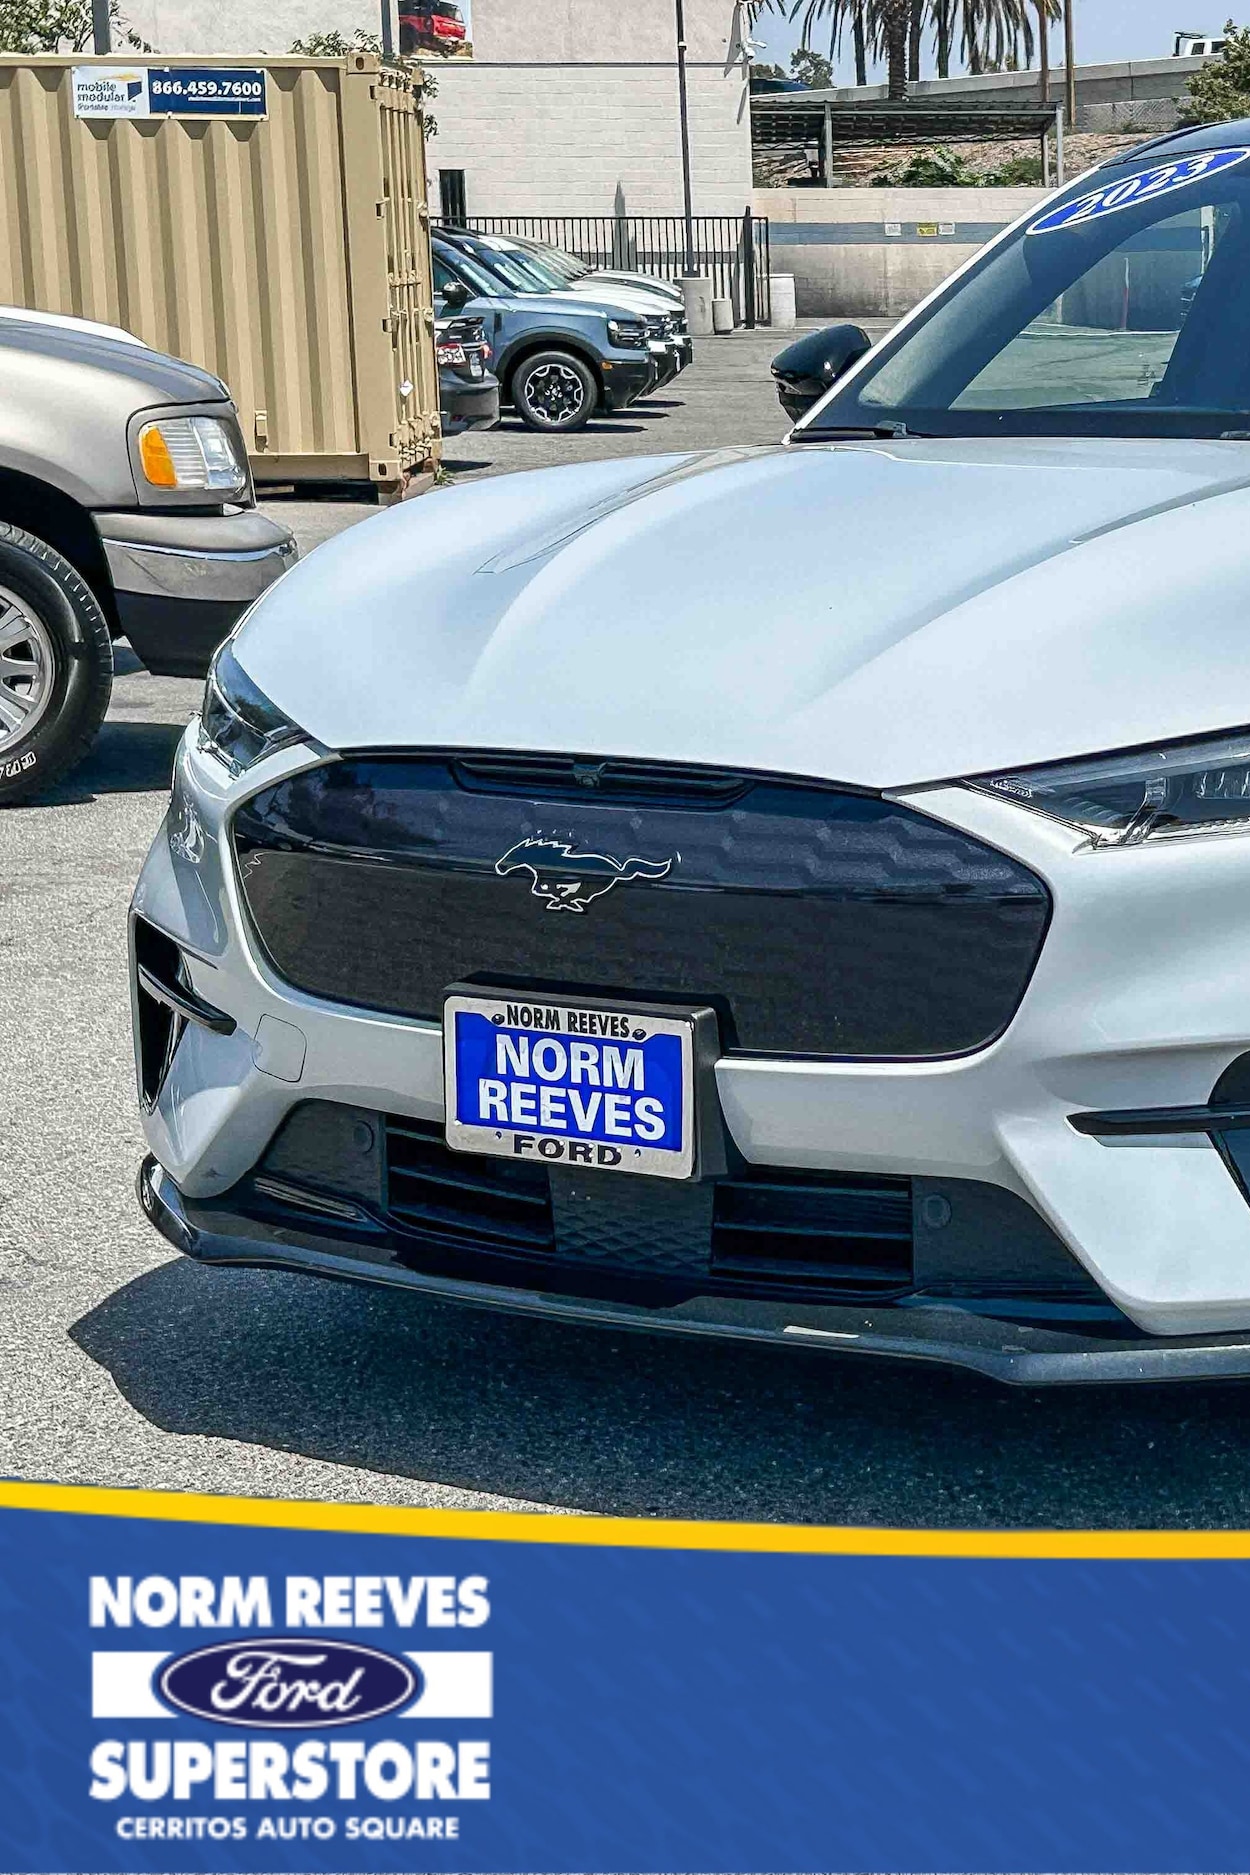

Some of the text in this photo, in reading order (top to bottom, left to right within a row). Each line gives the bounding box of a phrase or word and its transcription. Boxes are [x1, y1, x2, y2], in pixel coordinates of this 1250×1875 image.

[77, 81, 117, 91] mobile
[77, 92, 125, 102] modular
[152, 80, 262, 96] 866.459.7600
[1062, 155, 1215, 224] 2023
[507, 1004, 630, 1039] NORM REEVES
[495, 1033, 645, 1091] NORM
[478, 1078, 666, 1141] REEVES
[513, 1134, 622, 1166] FORD
